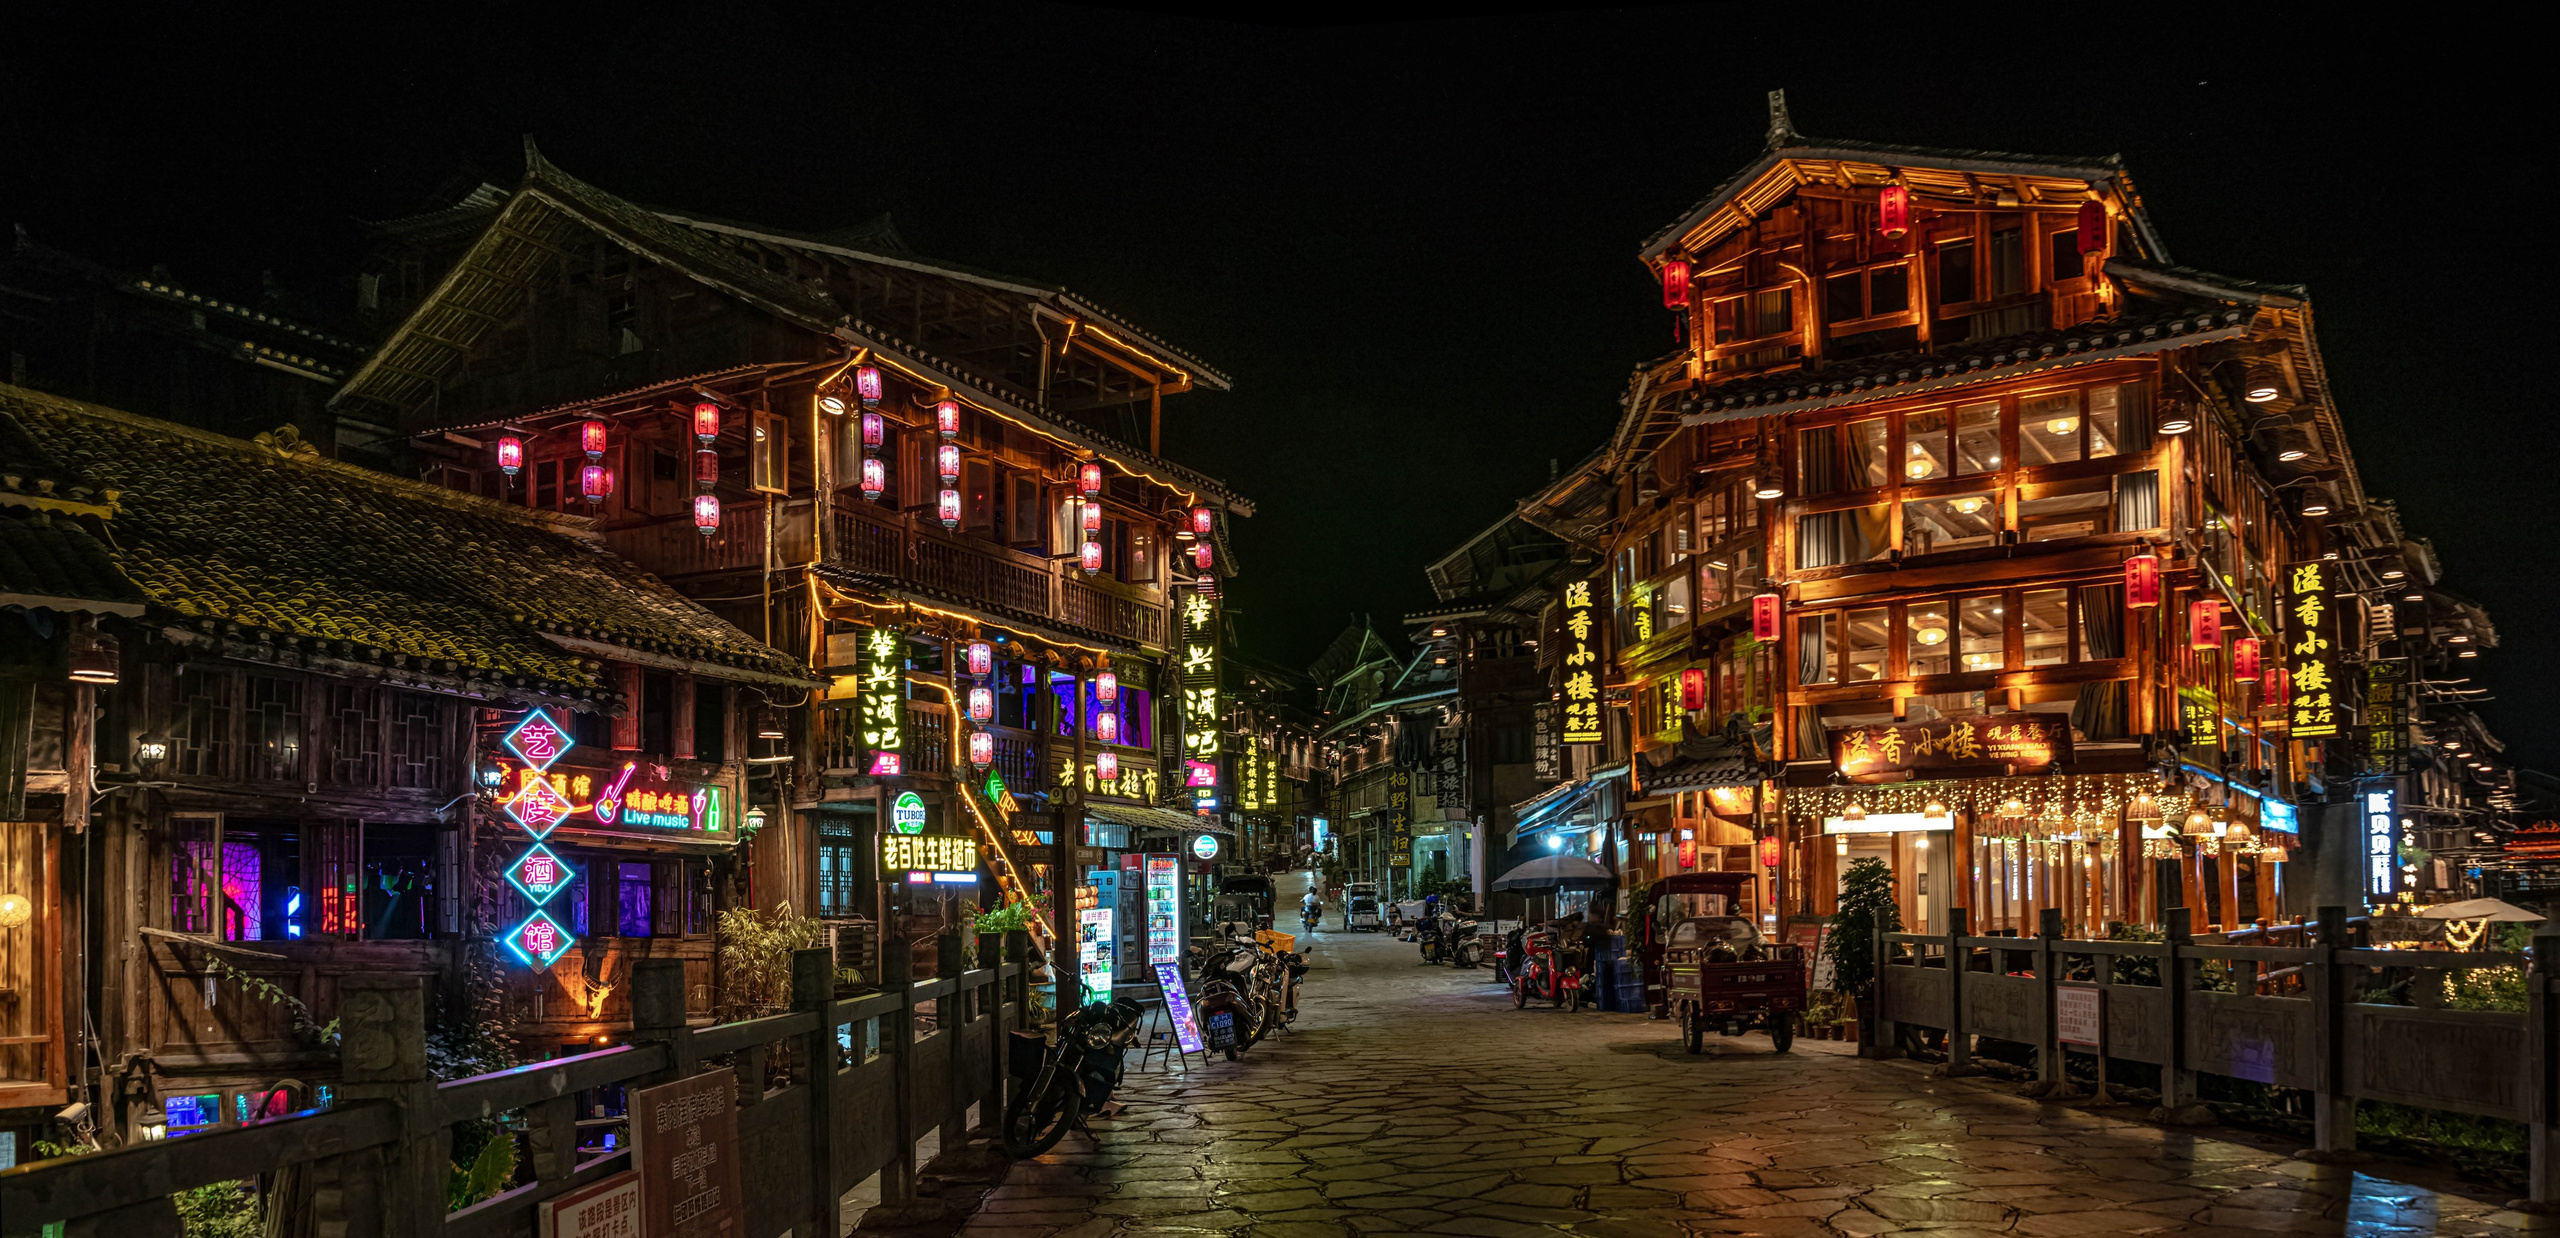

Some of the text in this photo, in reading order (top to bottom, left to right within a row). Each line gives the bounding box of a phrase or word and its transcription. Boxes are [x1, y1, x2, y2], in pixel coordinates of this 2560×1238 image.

[1563, 580, 1599, 701] 溢香小楼
[2291, 563, 2332, 692] 溢香小楼
[1534, 708, 1550, 773] 特色酸辣粉
[1840, 720, 1982, 767] 溢香小楼
[1986, 722, 2064, 742] 观景餐厅
[1440, 738, 1461, 808] 特色旅拍
[624, 808, 690, 829] Live music
[625, 788, 689, 814] 精酿啤酒
[521, 725, 557, 952] 艺度酒馆
[884, 835, 977, 872] 老百姓生鲜超市
[528, 884, 552, 893] YIDU
[1211, 1018, 1232, 1029] C1090
[578, 1188, 636, 1231] 该路段是景区内
